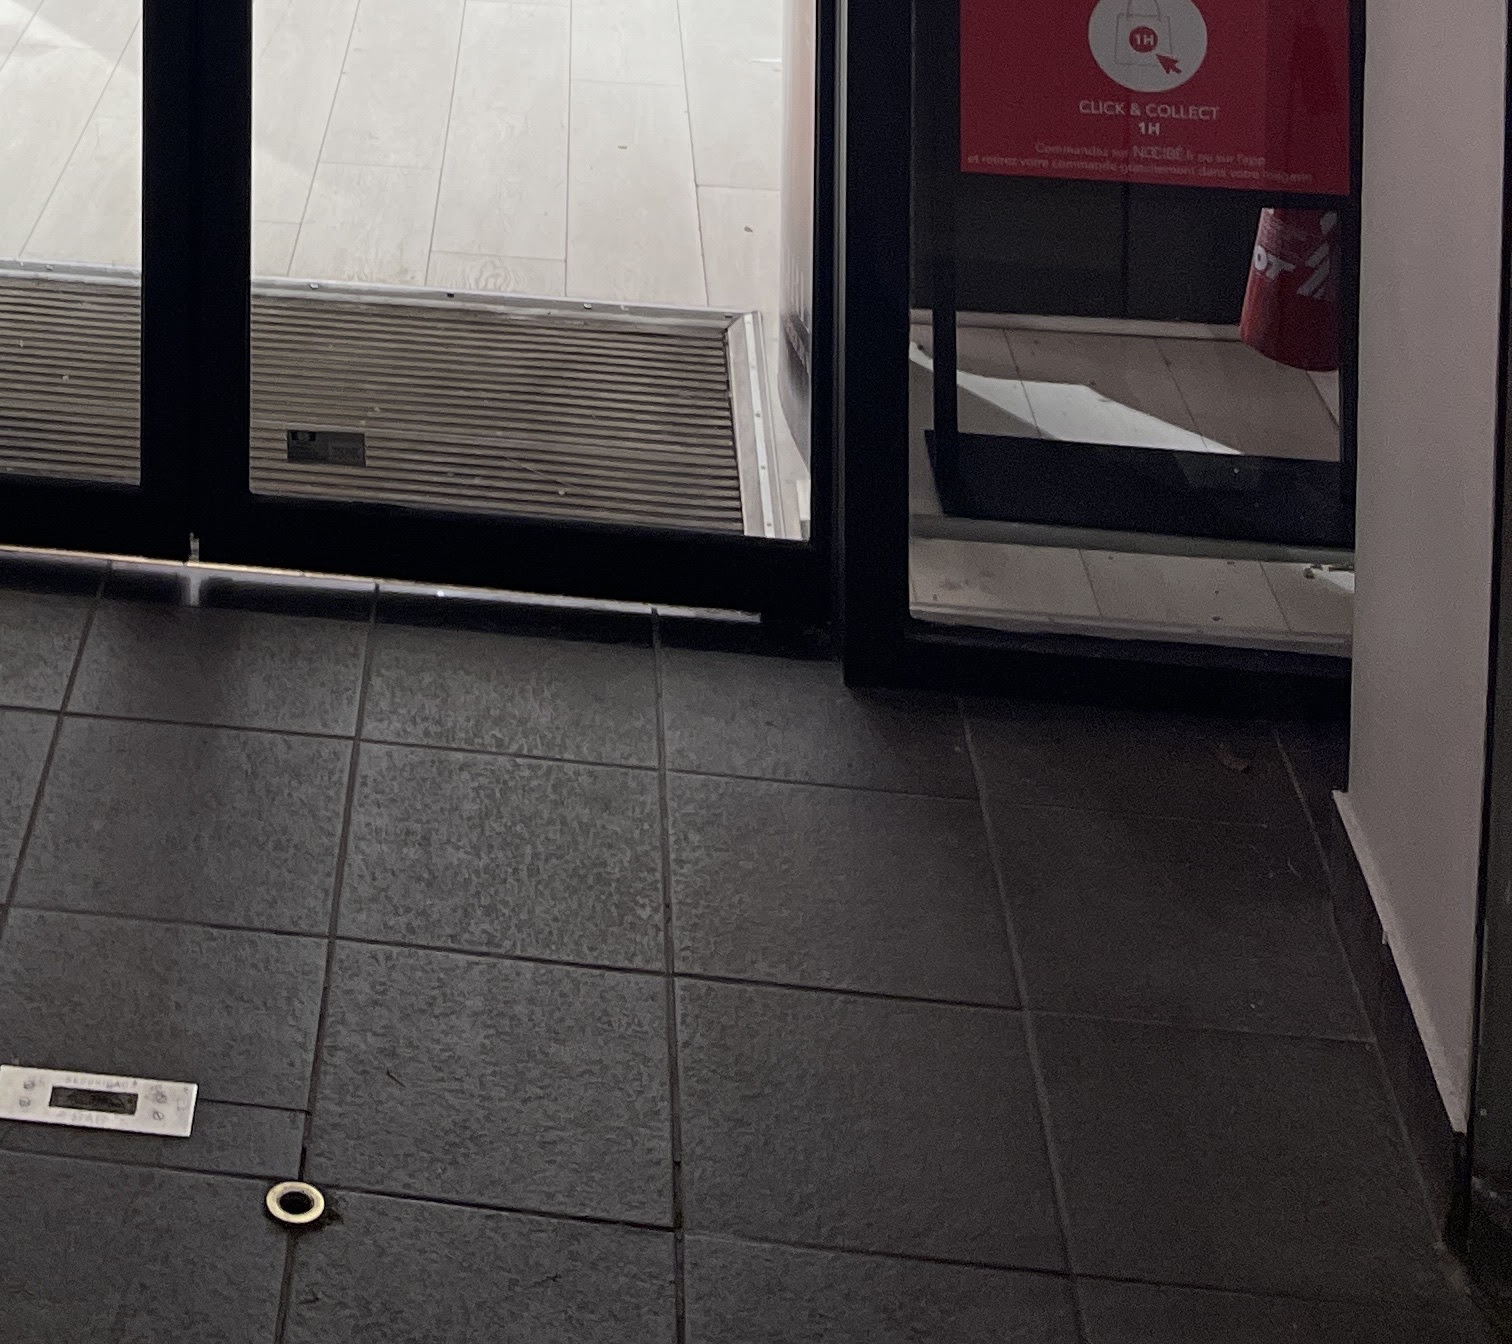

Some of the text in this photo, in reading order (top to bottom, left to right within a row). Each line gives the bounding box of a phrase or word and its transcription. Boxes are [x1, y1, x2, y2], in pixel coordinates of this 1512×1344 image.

[1134, 33, 1154, 46] 1H
[1079, 100, 1219, 120] CLICK & COLLECT
[1138, 121, 1161, 136] 1H
